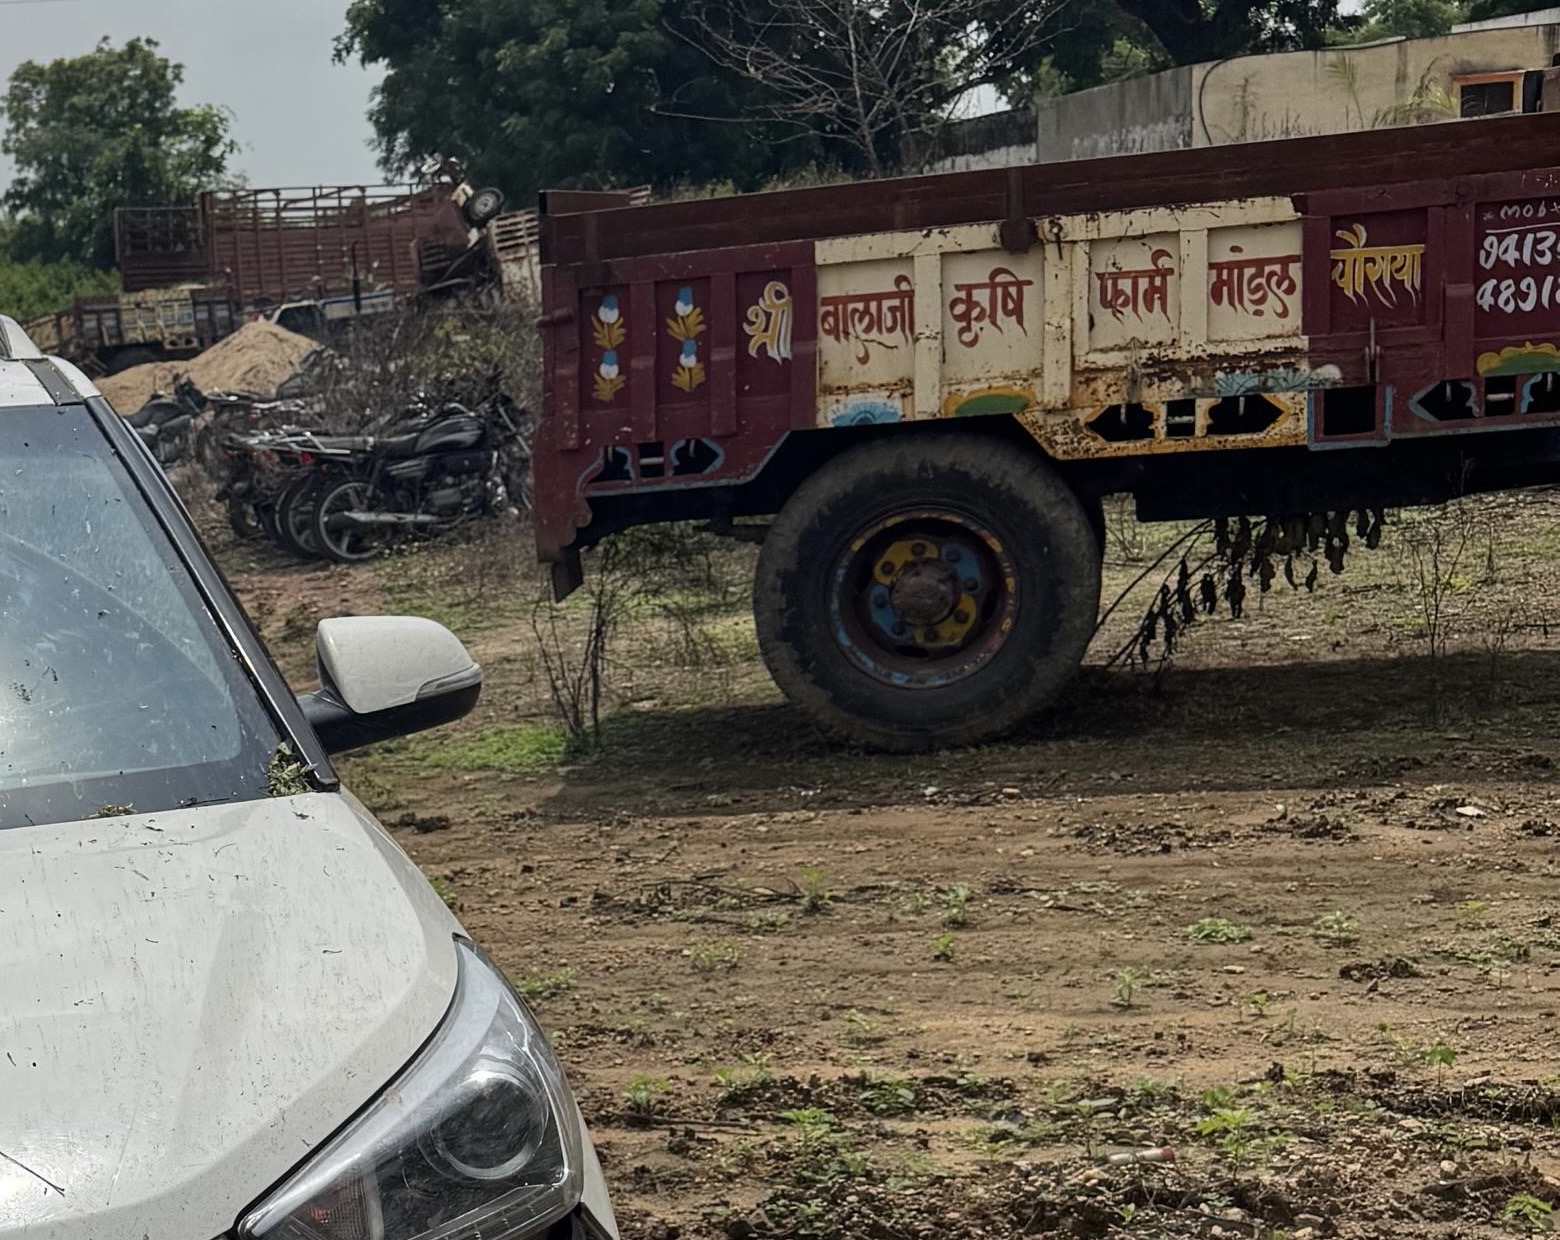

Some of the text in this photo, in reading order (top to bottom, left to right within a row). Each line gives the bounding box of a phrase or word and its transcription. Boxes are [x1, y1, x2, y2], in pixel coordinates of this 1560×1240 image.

[1480, 231, 1560, 270] 9413
[742, 281, 792, 365] श्री
[820, 274, 915, 365] बालाजी
[949, 267, 1034, 348] कृषि
[1095, 249, 1175, 325] फार्म
[1477, 275, 1560, 314] 4891
